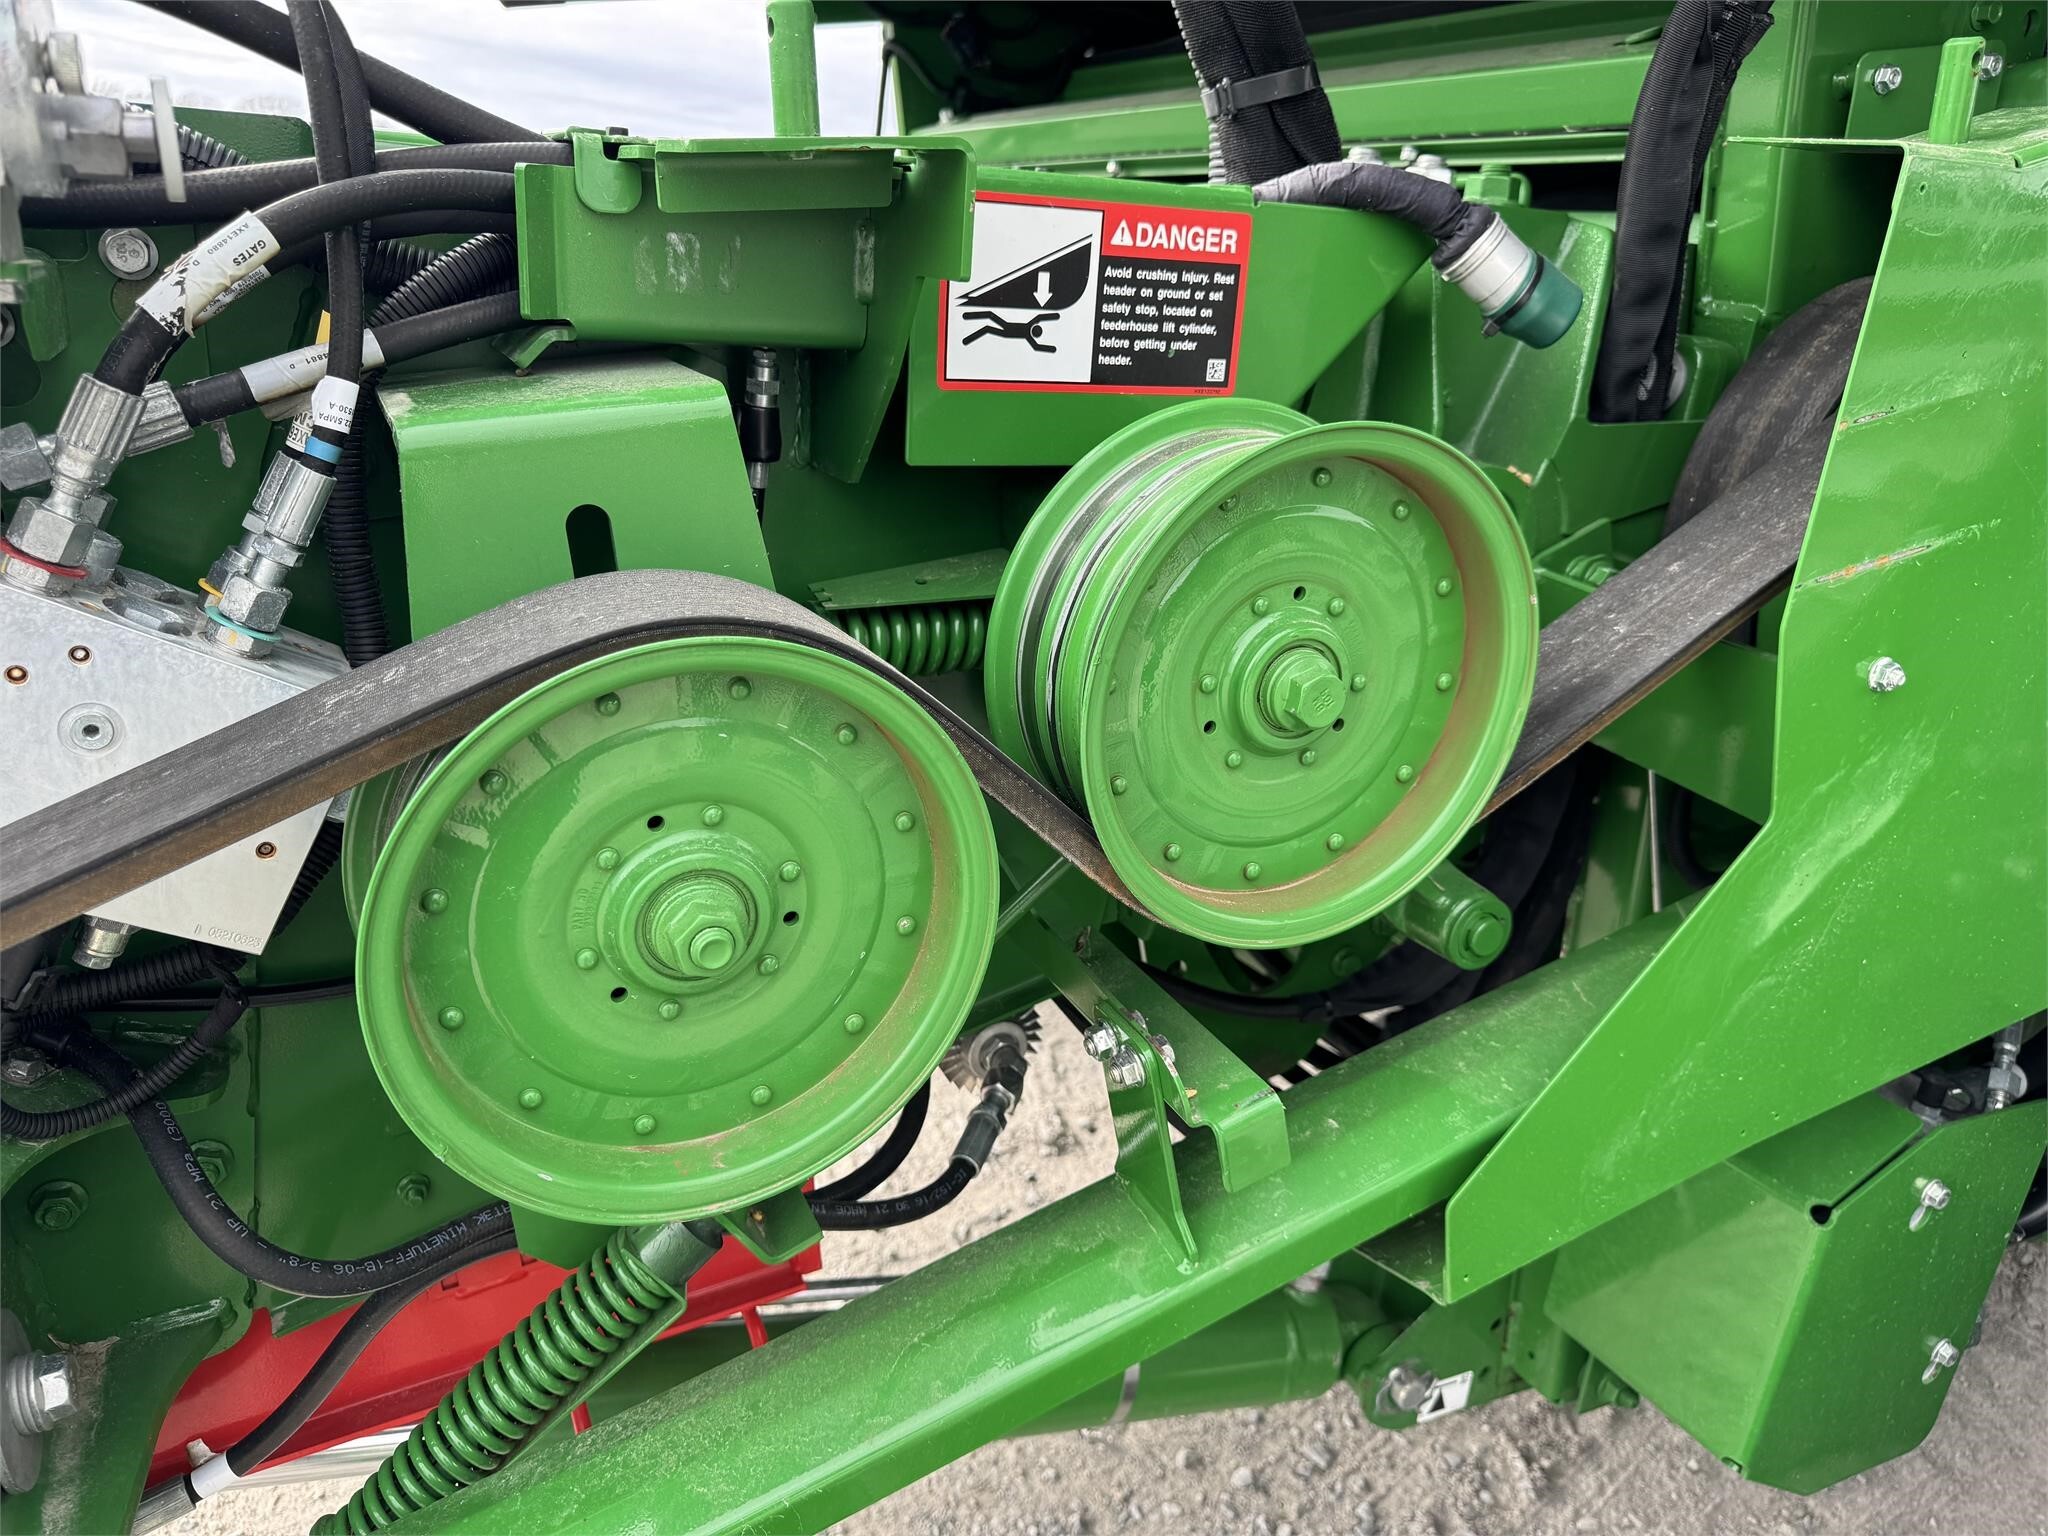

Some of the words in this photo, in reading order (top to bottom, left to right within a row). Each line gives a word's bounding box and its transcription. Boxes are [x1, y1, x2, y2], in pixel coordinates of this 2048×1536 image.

[1135, 222, 1238, 254] DANGER
[232, 239, 268, 267] GATES
[1104, 265, 1133, 279] Avoid
[1136, 268, 1178, 284] crushing
[1181, 270, 1210, 286] injury.
[1213, 272, 1235, 285] Rest
[1103, 283, 1137, 297] header
[1140, 286, 1153, 298] on
[1157, 288, 1191, 300] ground
[1194, 290, 1205, 300] or
[1208, 290, 1223, 301] set
[1102, 301, 1131, 316] safety
[1135, 303, 1159, 317] stop,
[1162, 304, 1197, 317] located
[1200, 307, 1213, 318] on
[1100, 319, 1159, 333] feederhouse
[1162, 321, 1175, 333] lift
[1179, 322, 1218, 336] cylinder,
[1099, 336, 1130, 349] before
[1133, 338, 1167, 352] getting
[1170, 340, 1198, 351] under
[1098, 353, 1132, 366] header.
[184, 1152, 205, 1183] MPa
[205, 1191, 225, 1211] 21
[226, 1217, 249, 1238] WP
[278, 1255, 322, 1274] 3/8"
